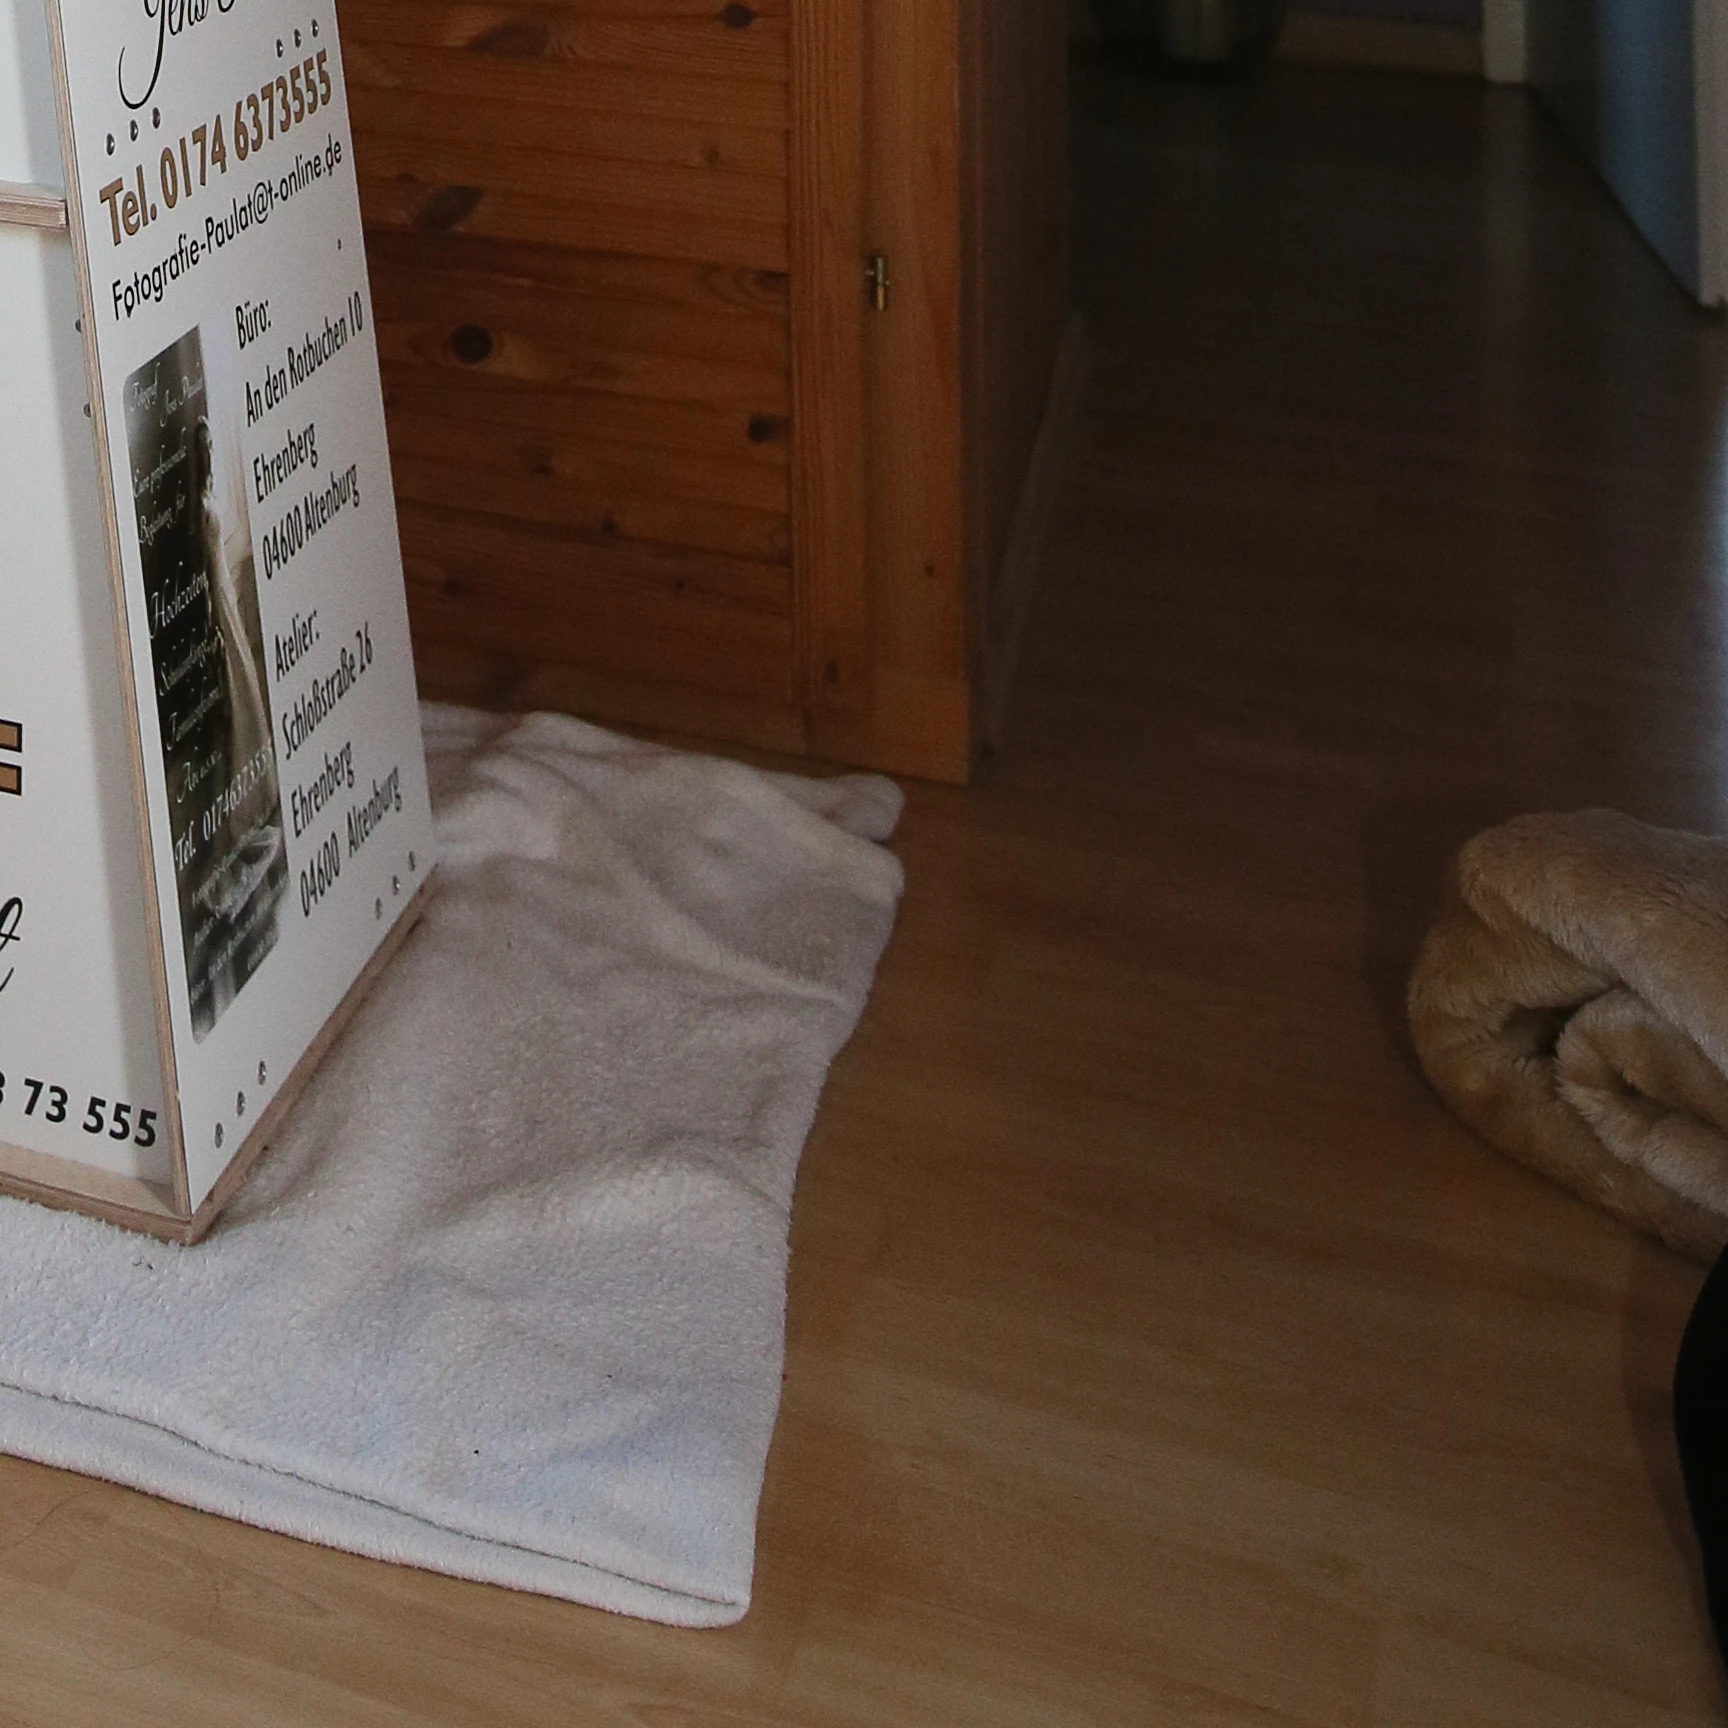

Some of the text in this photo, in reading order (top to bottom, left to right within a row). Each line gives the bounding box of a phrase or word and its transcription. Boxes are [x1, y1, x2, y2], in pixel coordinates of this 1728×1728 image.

[99, 48, 333, 247] Tel. 0174 6373555
[112, 132, 343, 322] Fotografie-Paulat@t-online.de
[235, 299, 272, 351] Büro:
[244, 290, 364, 428] An den Rotbuchen 10
[252, 421, 318, 505] Ehrenberg
[262, 463, 360, 581] 04600 Altenburg
[274, 609, 320, 683] Atelier:
[282, 620, 373, 761] Schloßstraße 26
[290, 741, 354, 839] Ehrenberg
[299, 765, 402, 919] 04600 Altenburg
[174, 819, 197, 872] Tel.
[23, 1078, 69, 1124] 73
[82, 1095, 159, 1148] 555
